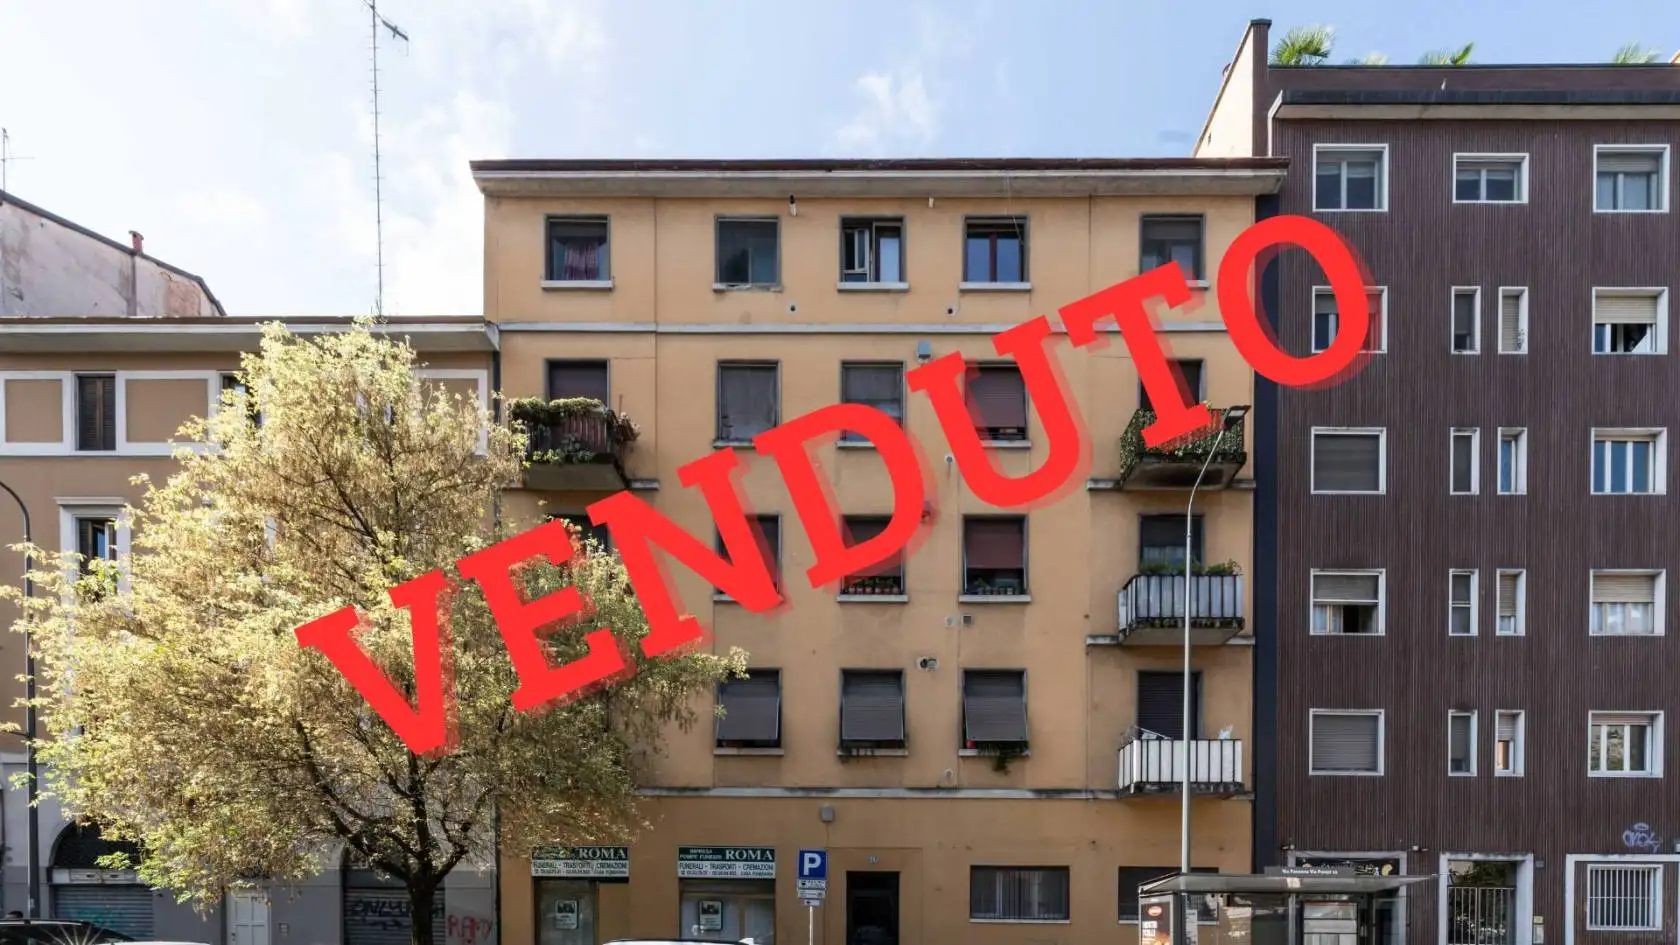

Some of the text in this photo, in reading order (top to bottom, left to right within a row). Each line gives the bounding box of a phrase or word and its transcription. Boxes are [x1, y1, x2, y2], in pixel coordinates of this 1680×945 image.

[578, 847, 626, 859] ROMA
[725, 849, 774, 860] ROMA
[803, 852, 821, 876] P
